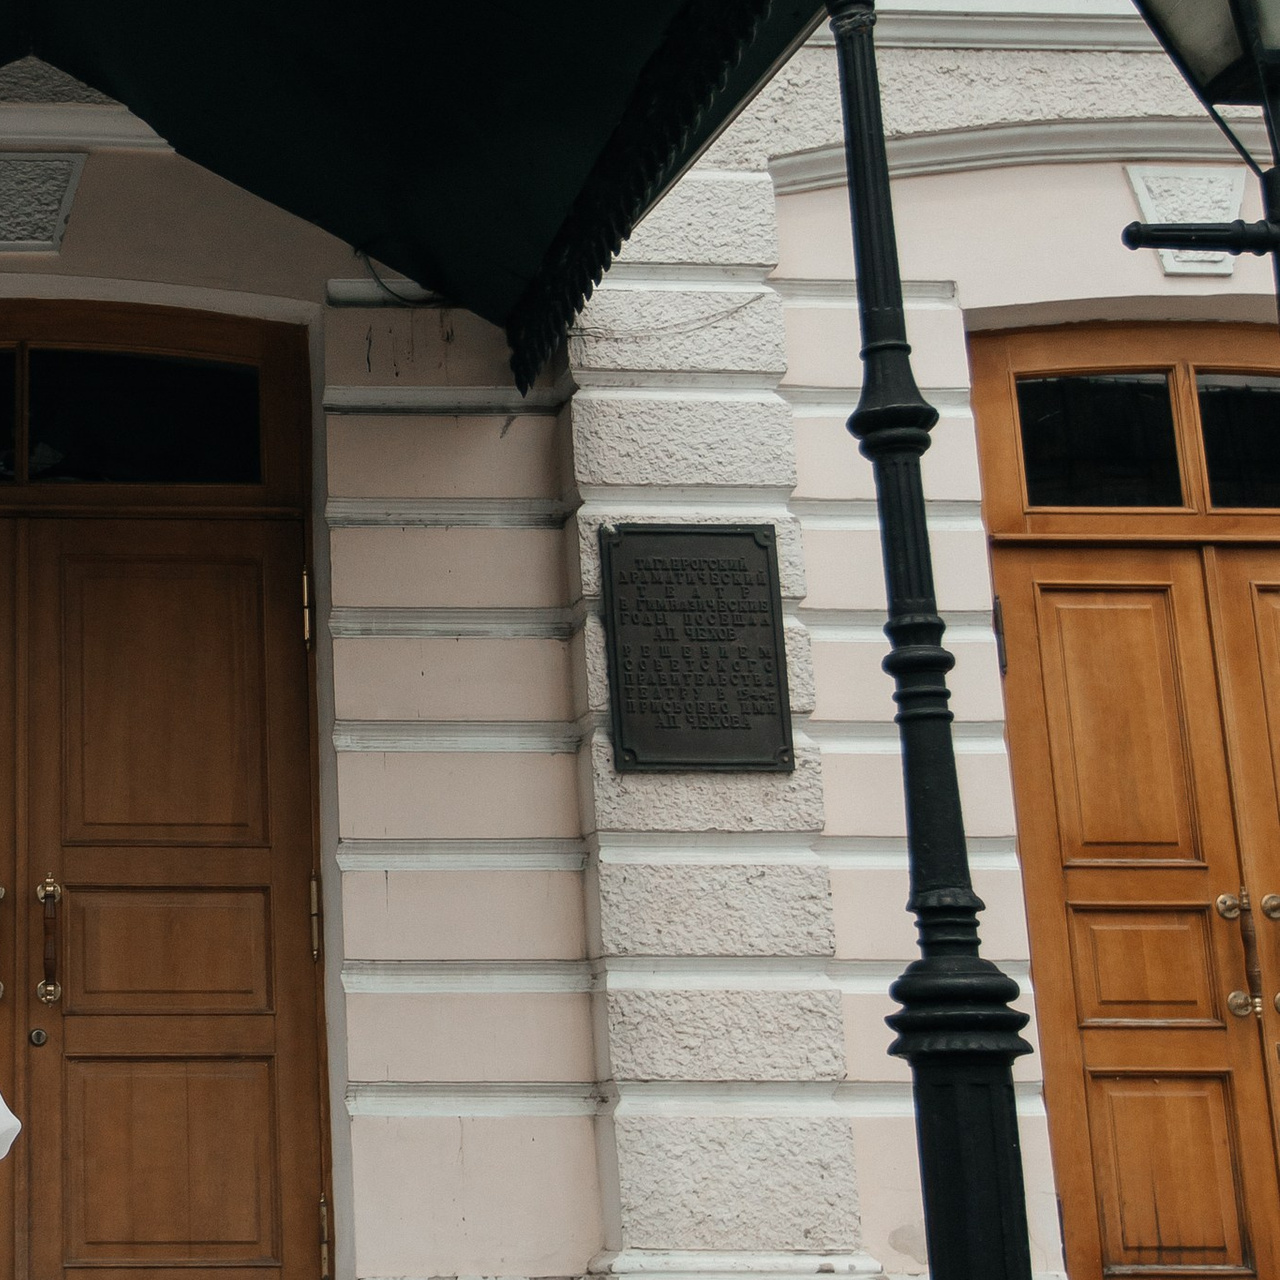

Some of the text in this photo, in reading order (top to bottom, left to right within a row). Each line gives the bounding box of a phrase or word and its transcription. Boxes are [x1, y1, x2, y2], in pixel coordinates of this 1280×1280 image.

[634, 556, 748, 572] ТАГАНРОГСКИЙ
[618, 570, 766, 586] ДРАМАТИЧЕСКИЙ
[636, 585, 750, 599] ТЕАТР
[619, 597, 768, 613] В ГИМНАЗИЧЕСКИЕ
[620, 612, 770, 627] ГОДЫ ПОСЕЩАЛ
[684, 626, 737, 642] ЧЕХОВ
[623, 644, 772, 659] РЕШЕНИЕМ
[623, 658, 772, 672] СОВЕТСКОГО
[624, 672, 774, 687] ПРАВИТЕЛЬСТВА
[624, 686, 699, 700] ТЕАТРУ
[716, 687, 725, 700] В
[626, 700, 777, 715] ПРИСВОЕНО ИМЯ
[686, 714, 752, 730] ЧЕХОВА
